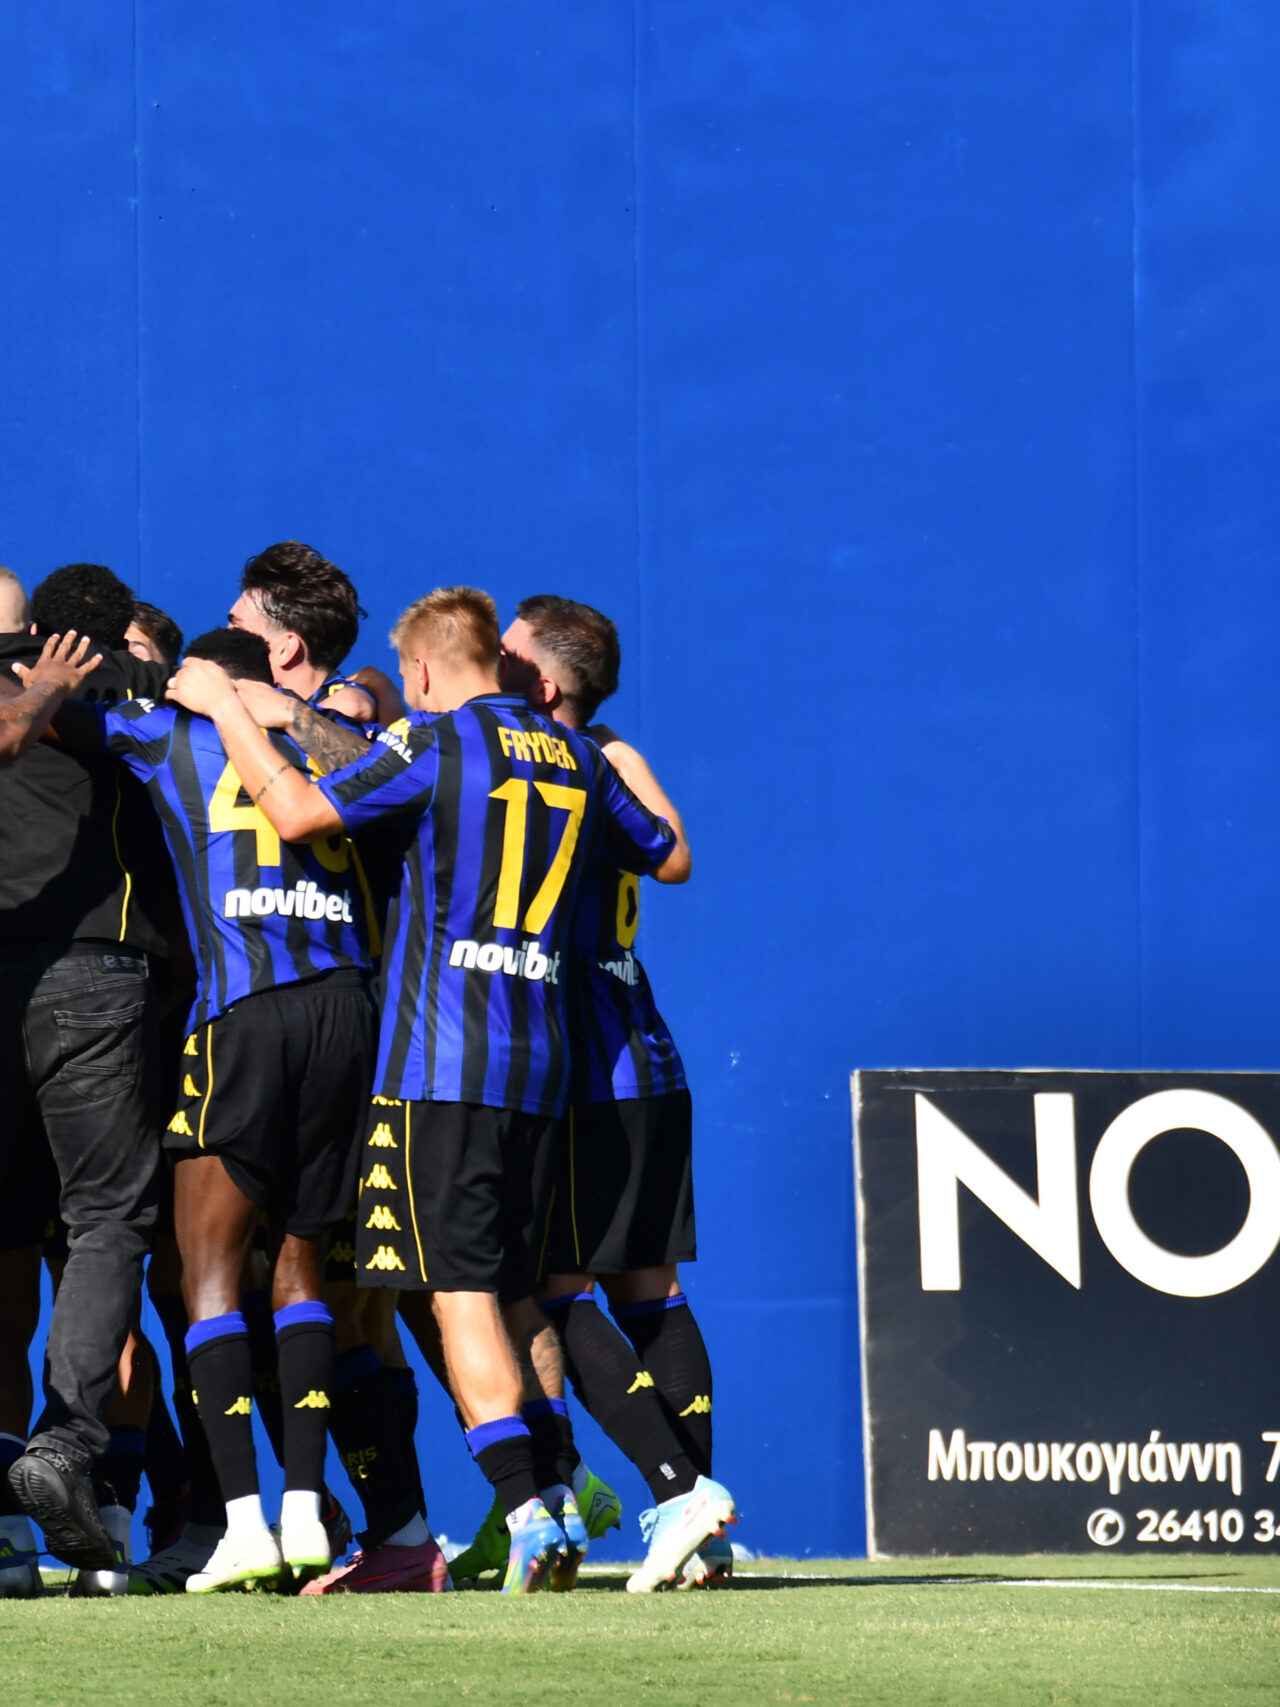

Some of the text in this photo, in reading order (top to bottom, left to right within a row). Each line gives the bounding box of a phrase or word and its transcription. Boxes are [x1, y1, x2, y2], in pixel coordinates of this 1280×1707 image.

[497, 726, 577, 771] FRYDEK
[488, 777, 587, 935] 17
[224, 880, 353, 924] novibet
[448, 940, 561, 985] novibet
[915, 1088, 1280, 1297] NO
[927, 1428, 1242, 1496] Μπουκογιάννη
[1136, 1508, 1280, 1543] 26410 3
